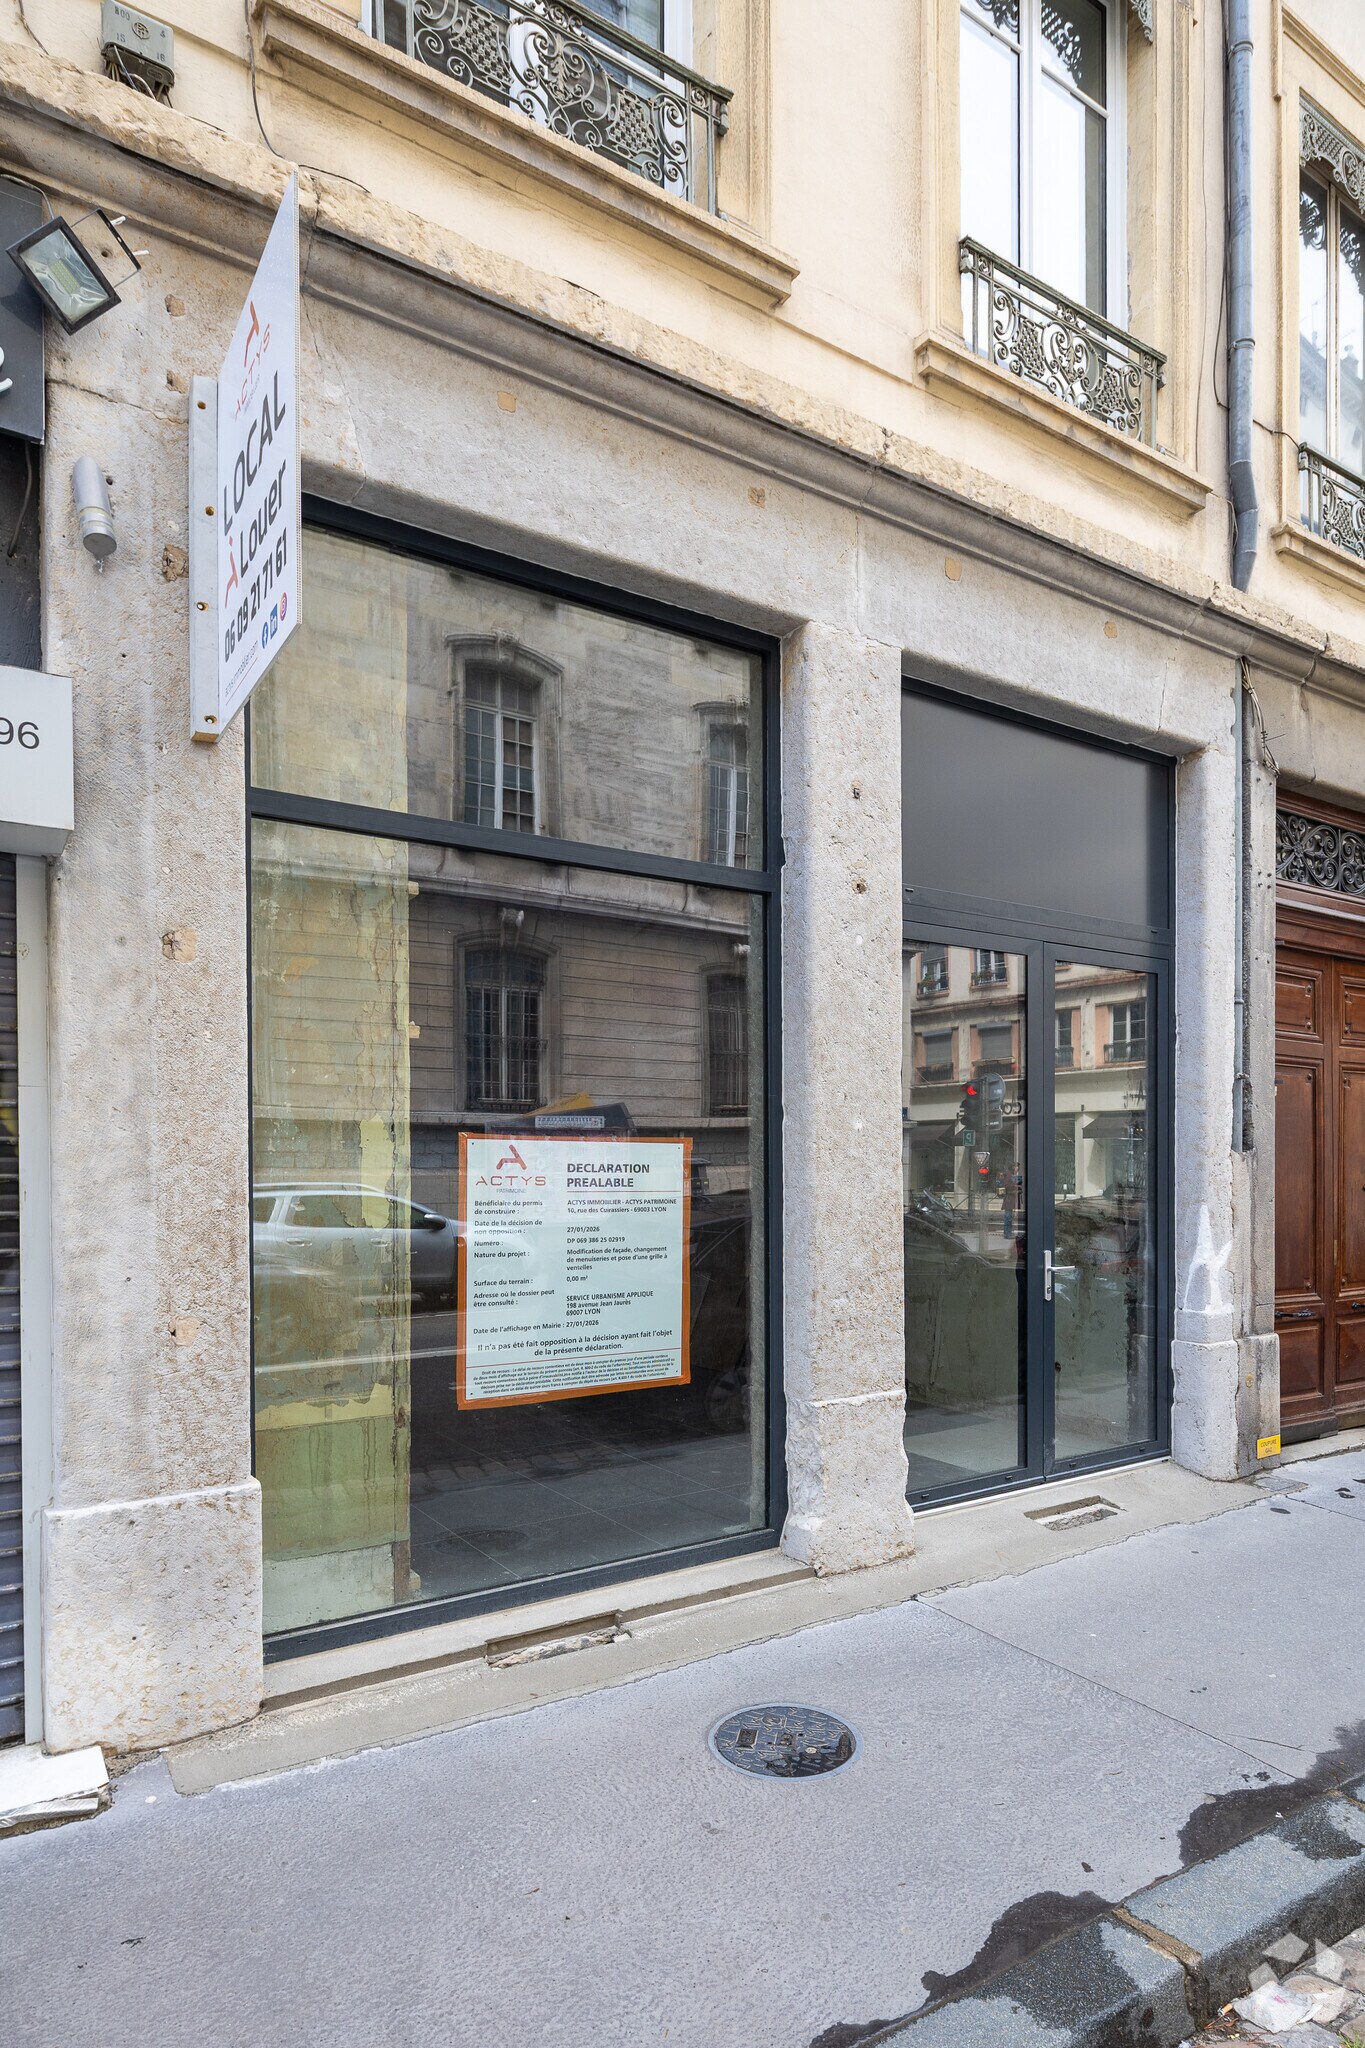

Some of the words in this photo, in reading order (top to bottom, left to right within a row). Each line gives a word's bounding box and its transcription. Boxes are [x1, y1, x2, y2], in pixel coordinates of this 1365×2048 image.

[235, 323, 270, 422] ACTYS
[224, 370, 286, 536] LOCAL
[240, 459, 286, 578] Louer
[225, 619, 235, 663] 06
[237, 597, 248, 642] 09
[251, 574, 260, 621] 21
[263, 552, 272, 600] 71
[276, 527, 286, 578] 61
[568, 1164, 649, 1173] DECLARATION
[476, 1176, 546, 1186] ACTYS
[567, 1178, 634, 1187] PREALABLE
[500, 1325, 531, 1334] l'affichage
[566, 1320, 599, 1328] 27/01/2026
[592, 1334, 619, 1342] décision
[653, 1329, 672, 1338] l'objet
[554, 1346, 583, 1356] présente
[585, 1342, 623, 1352] déclaration.
